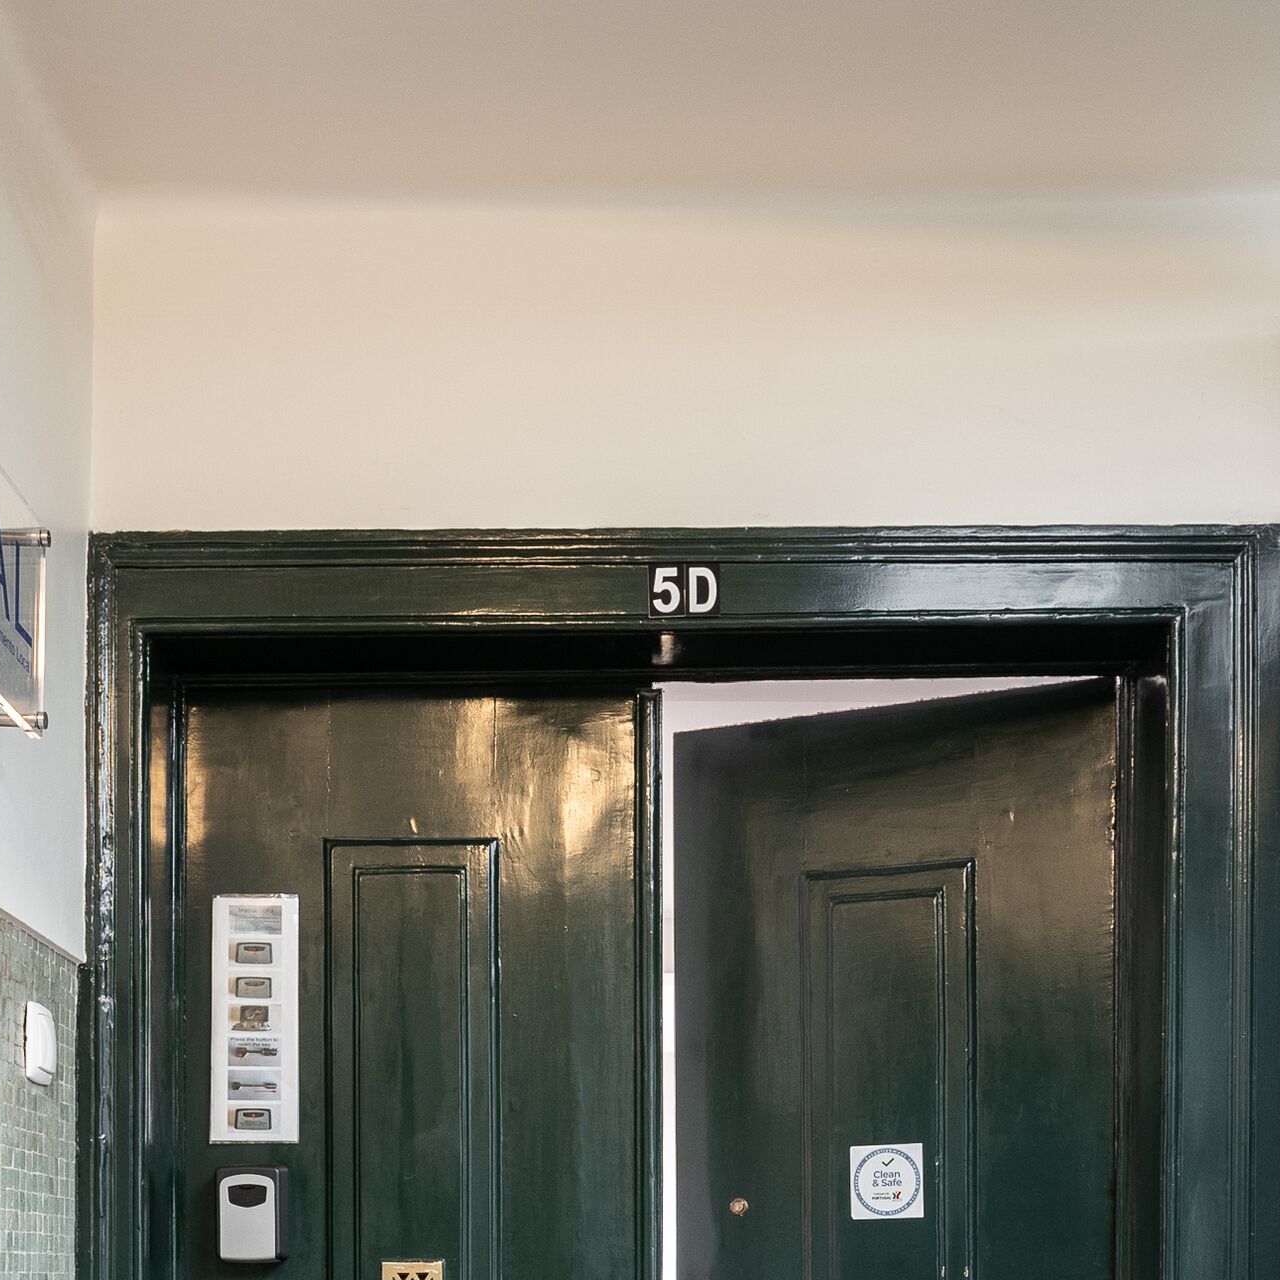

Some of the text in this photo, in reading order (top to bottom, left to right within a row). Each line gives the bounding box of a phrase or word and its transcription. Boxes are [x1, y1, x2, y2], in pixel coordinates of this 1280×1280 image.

[652, 566, 718, 614] 5D
[873, 1170, 901, 1179] Clean
[872, 1178, 903, 1187] & Safe
